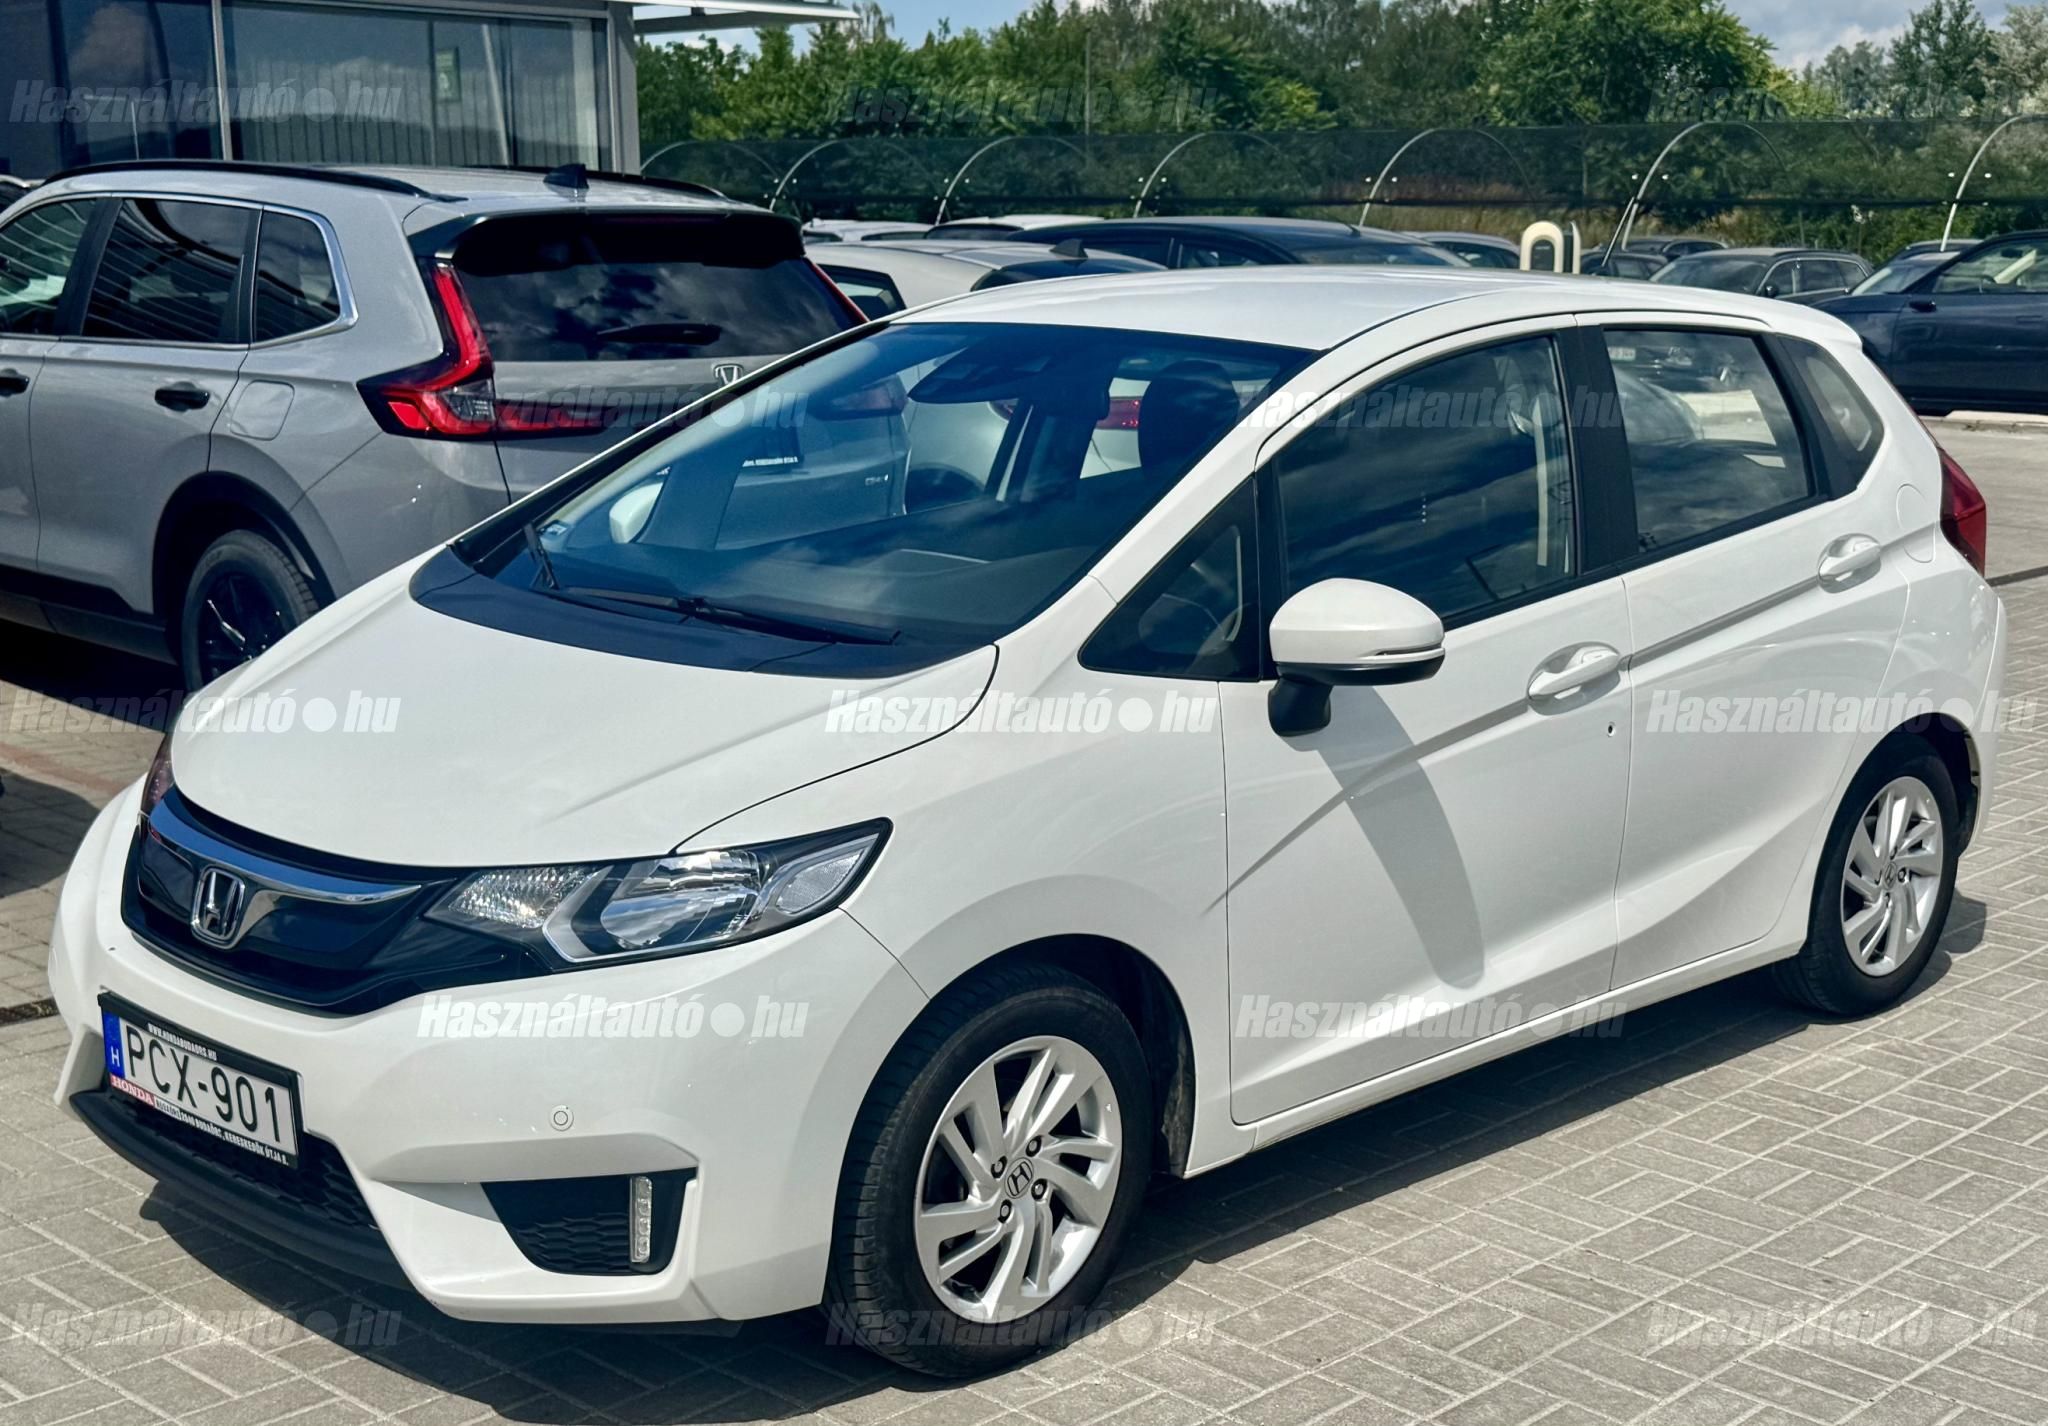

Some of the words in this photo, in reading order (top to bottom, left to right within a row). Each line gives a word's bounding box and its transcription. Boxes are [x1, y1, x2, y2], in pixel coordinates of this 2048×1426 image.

[110, 1046, 120, 1068] H
[111, 1074, 154, 1106] HONDA
[126, 1025, 280, 1143] PCX-901
